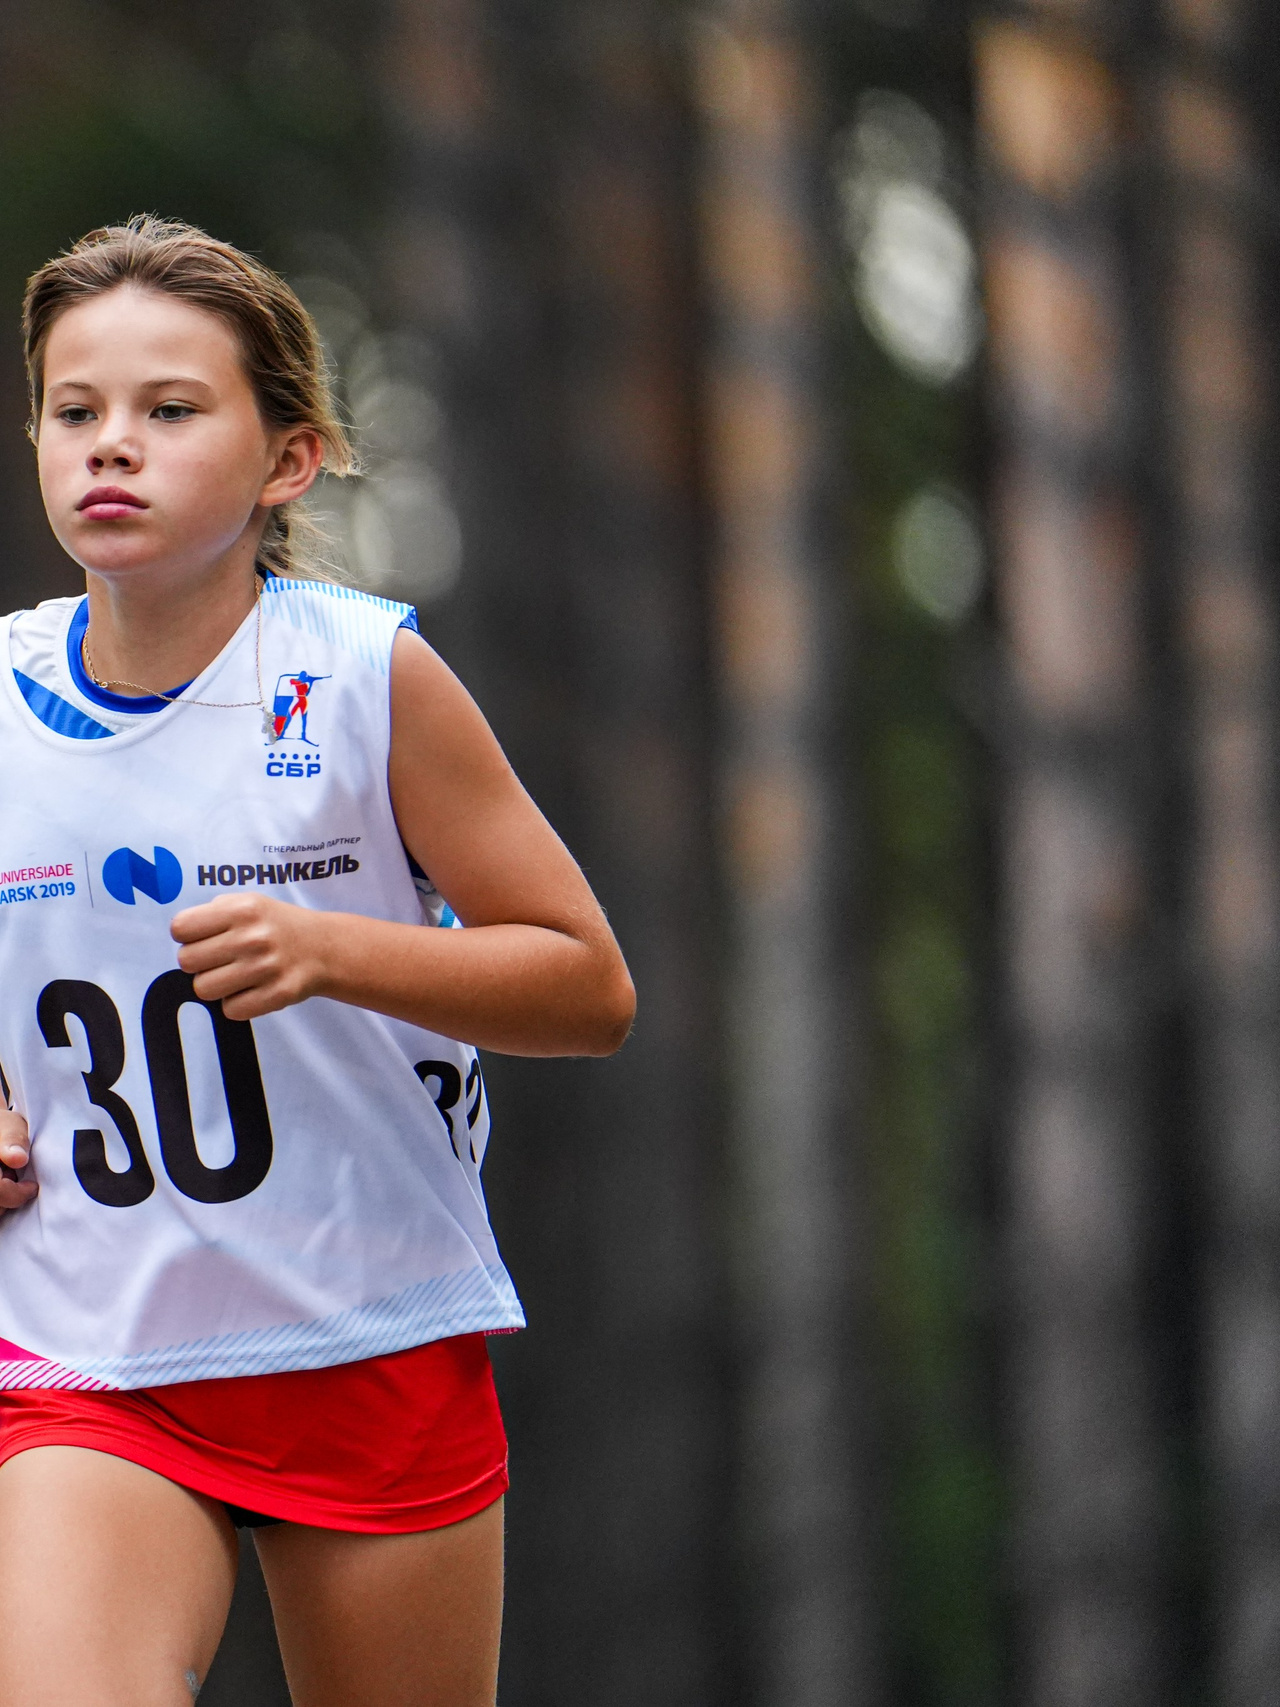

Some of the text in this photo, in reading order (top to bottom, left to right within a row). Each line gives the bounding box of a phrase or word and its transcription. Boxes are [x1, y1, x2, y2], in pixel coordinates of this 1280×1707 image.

[266, 761, 321, 778] СБР
[263, 836, 361, 853] ГЕНЕРАЛЬНЫЙ ПАРТНЕР
[197, 854, 360, 886] НОРНИКЕЛЬ
[39, 881, 76, 899] 2019
[36, 968, 274, 1208] 30
